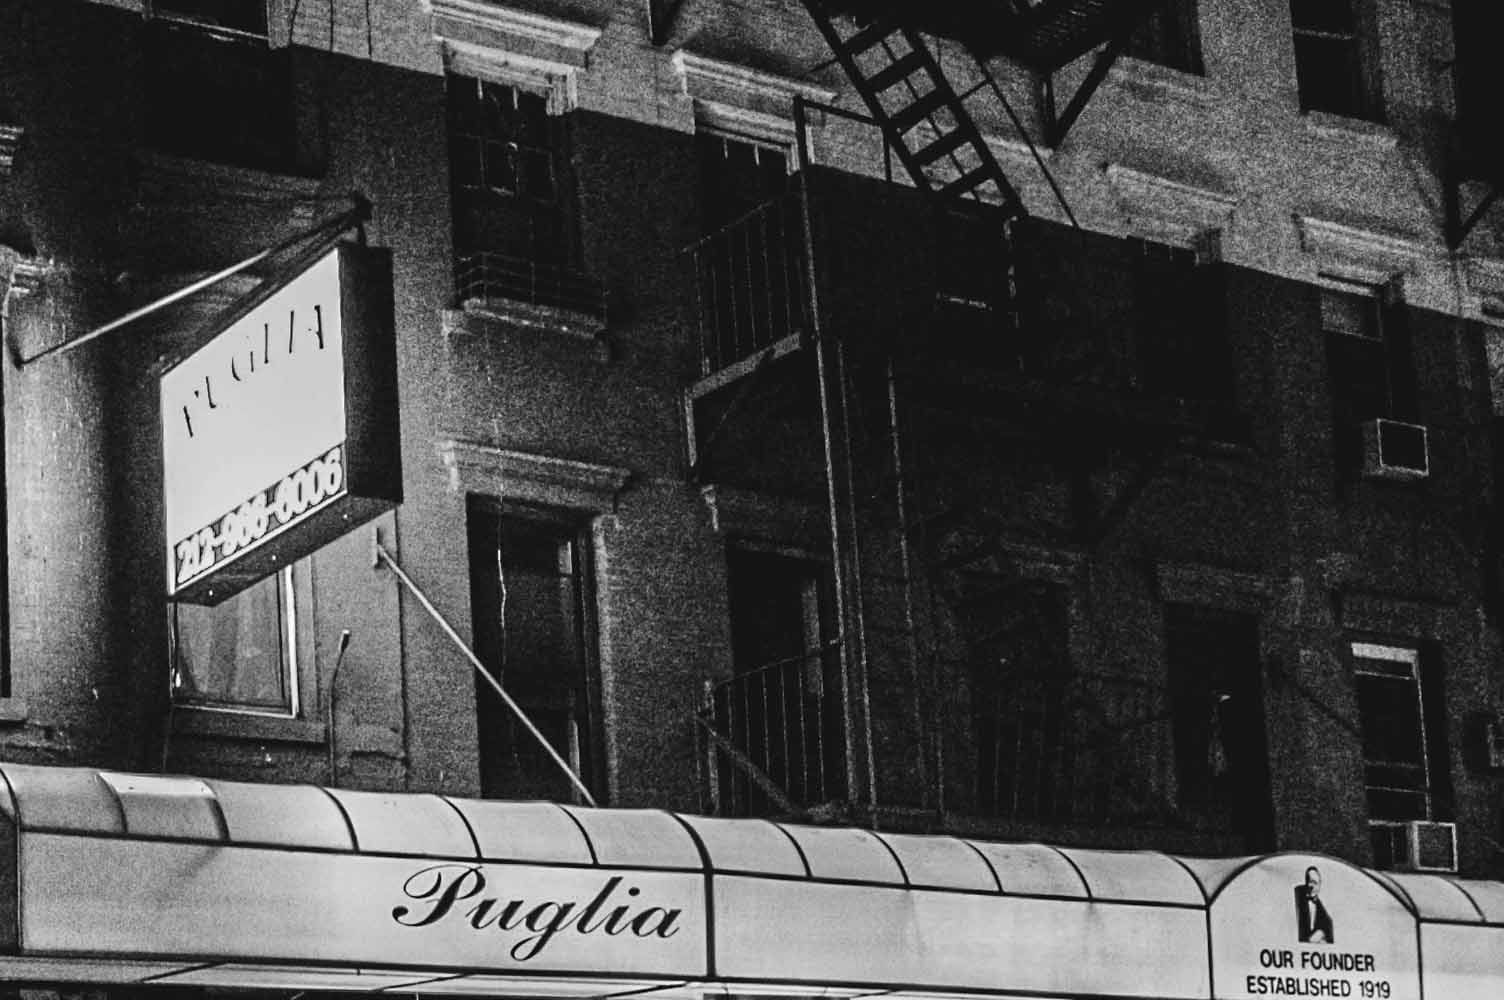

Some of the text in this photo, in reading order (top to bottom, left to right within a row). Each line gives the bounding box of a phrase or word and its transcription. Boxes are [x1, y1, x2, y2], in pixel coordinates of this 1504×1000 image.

[391, 865, 680, 961] Puglia
[1260, 949, 1375, 972] OUR FOUNDER
[1246, 976, 1391, 998] ESTABLISHED 1919
